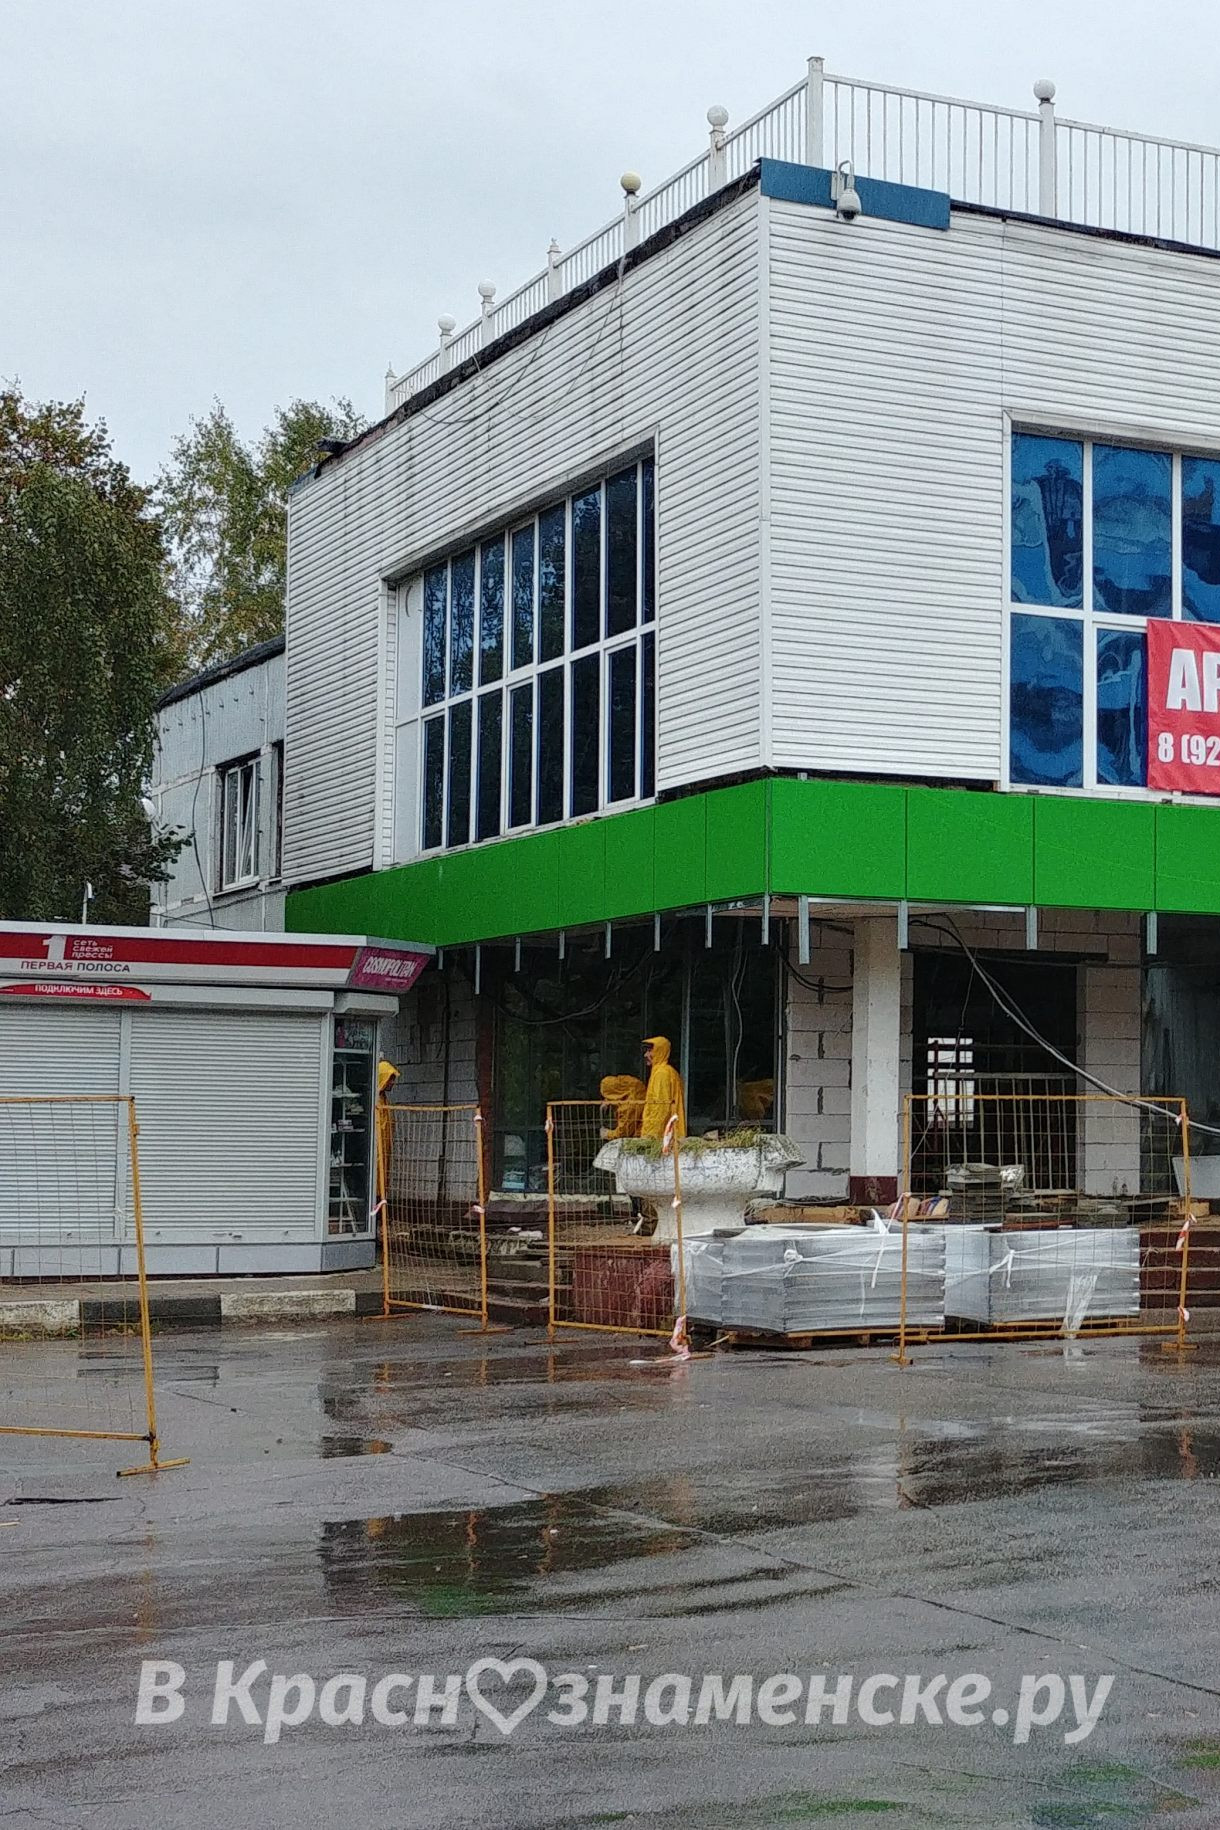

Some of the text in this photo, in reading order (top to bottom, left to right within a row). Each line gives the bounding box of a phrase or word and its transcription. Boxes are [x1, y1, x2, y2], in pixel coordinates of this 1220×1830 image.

[1157, 732, 1174, 763] 8
[42, 936, 67, 960] 1
[20, 960, 131, 973] ПЕРВАЯ ПОЛОСА
[34, 984, 123, 996] ПОДКЛЮЧИМ ЗДЕСЬ
